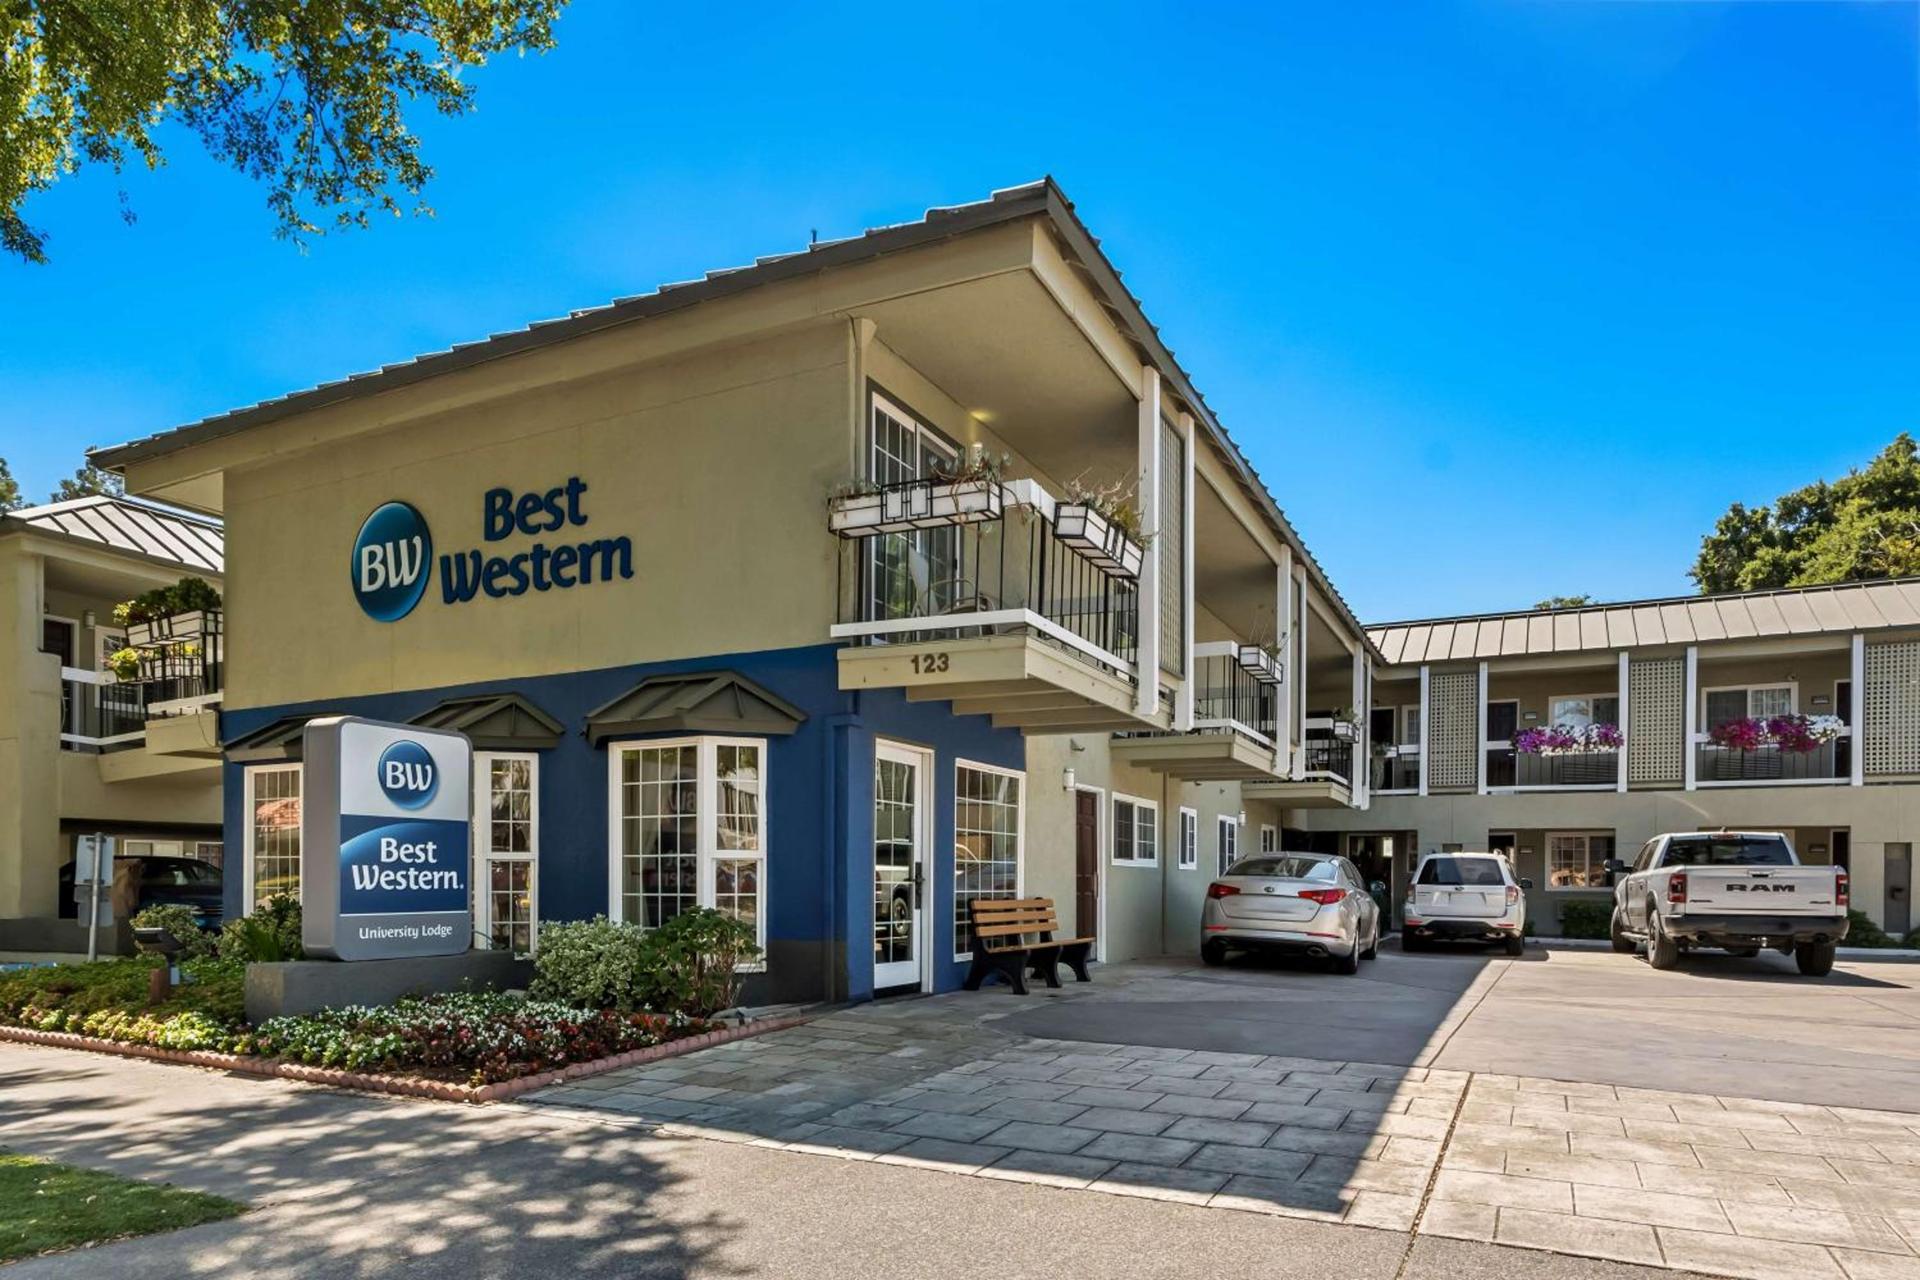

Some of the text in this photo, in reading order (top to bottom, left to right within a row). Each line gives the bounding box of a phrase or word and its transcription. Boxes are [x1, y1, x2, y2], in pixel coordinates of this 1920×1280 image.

[483, 476, 588, 542] Best
[360, 535, 422, 592] BW
[439, 536, 634, 605] Western
[911, 653, 948, 674] 123
[385, 761, 432, 790] BW
[380, 837, 437, 864] Best
[1726, 884, 1795, 892] RAM
[359, 924, 453, 939] University Lodge
